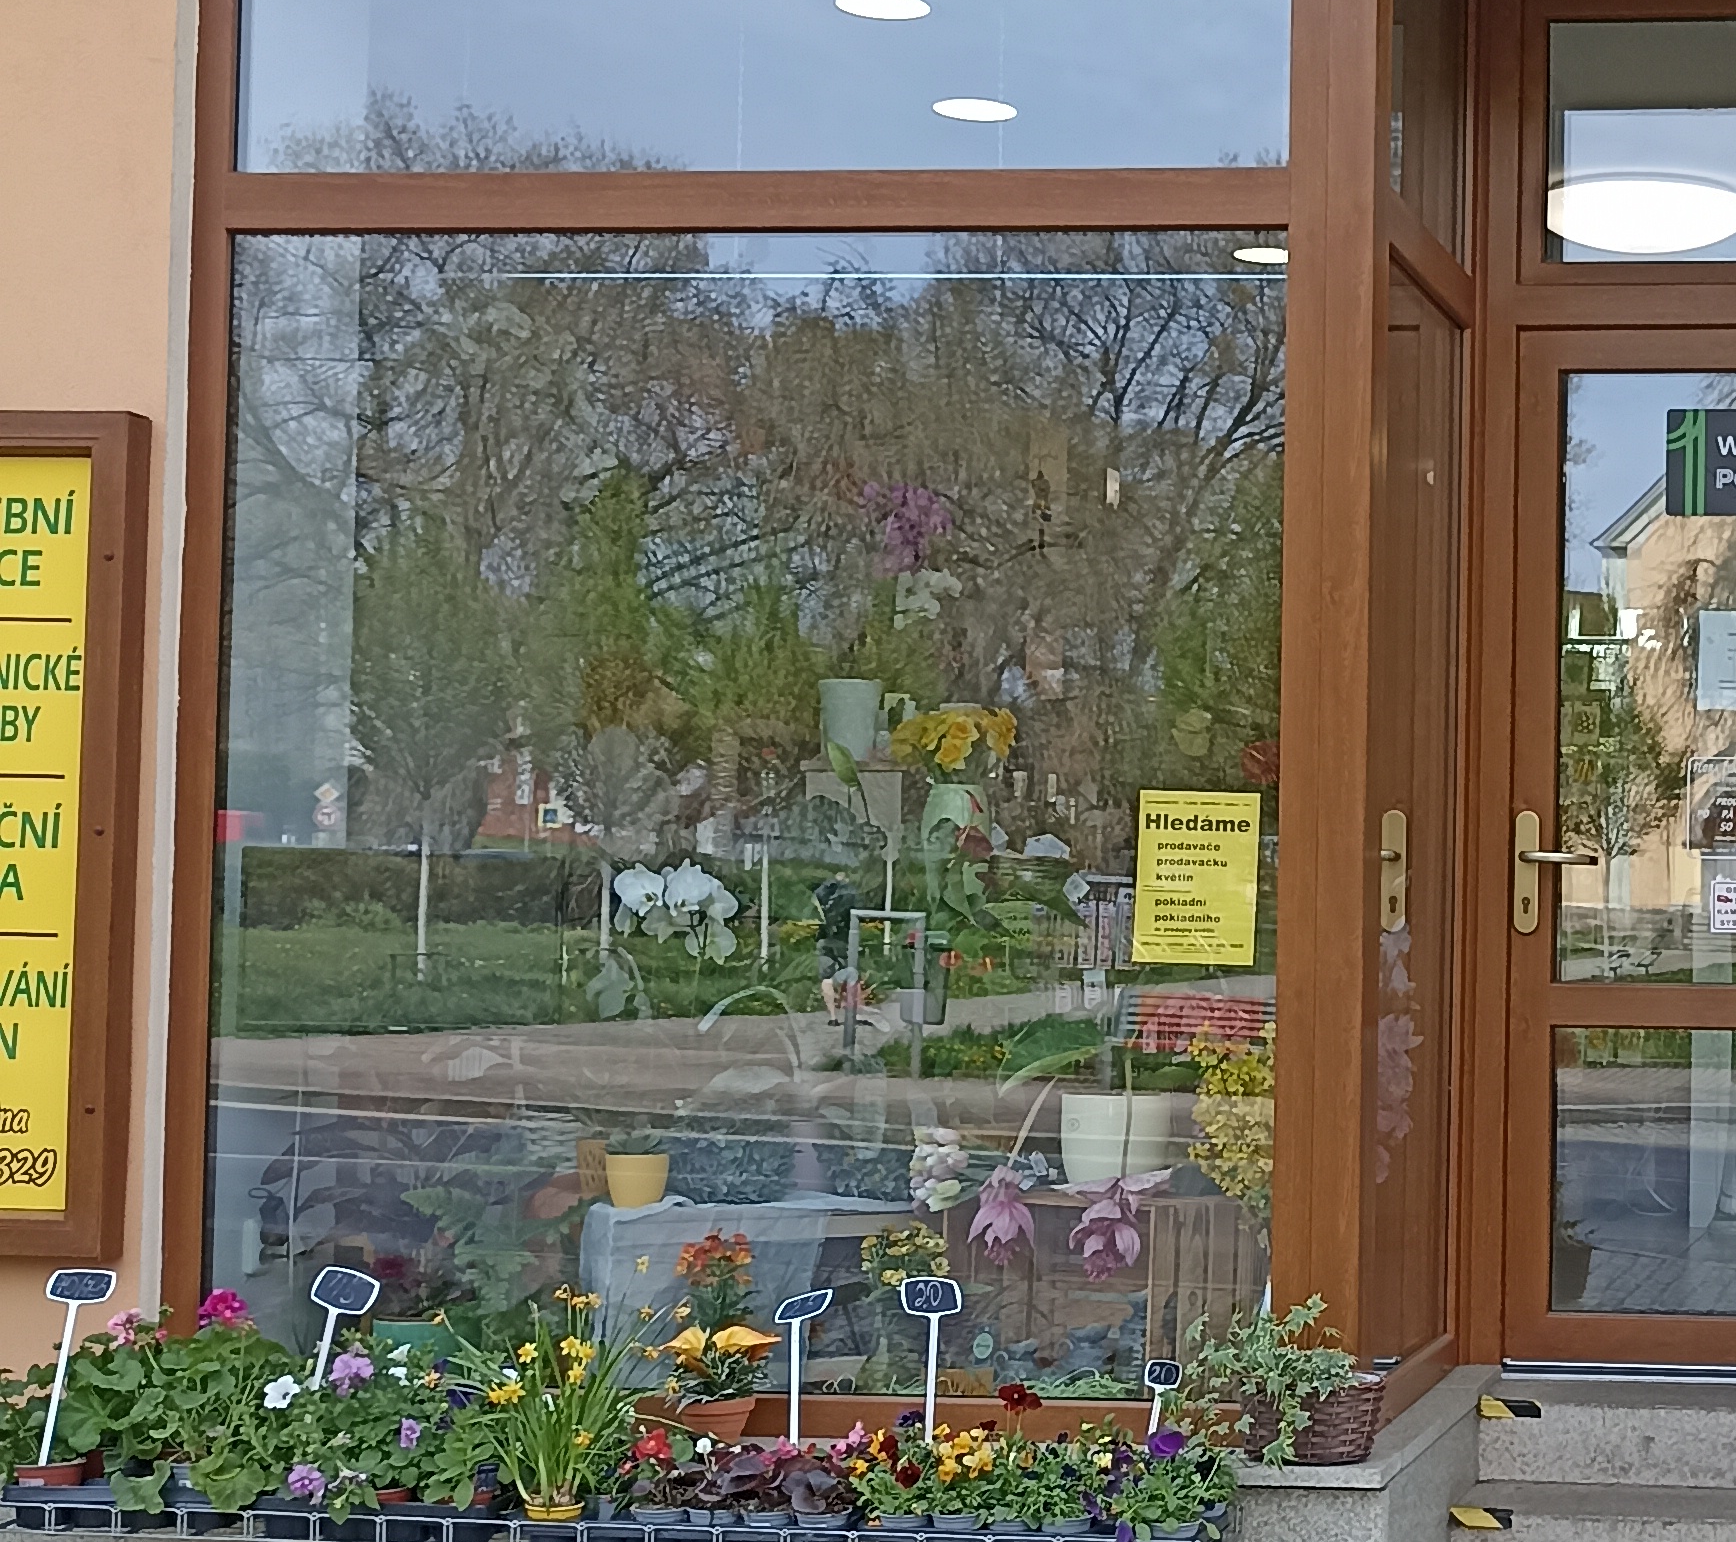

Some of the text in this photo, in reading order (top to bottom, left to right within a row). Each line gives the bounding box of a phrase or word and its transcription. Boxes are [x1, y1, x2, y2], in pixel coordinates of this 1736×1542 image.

[0, 490, 76, 535] BNÍ
[1145, 812, 1251, 833] Hledáme
[1719, 822, 1734, 832] SO
[1156, 858, 1228, 868] prodavačku
[1155, 873, 1194, 883] květin
